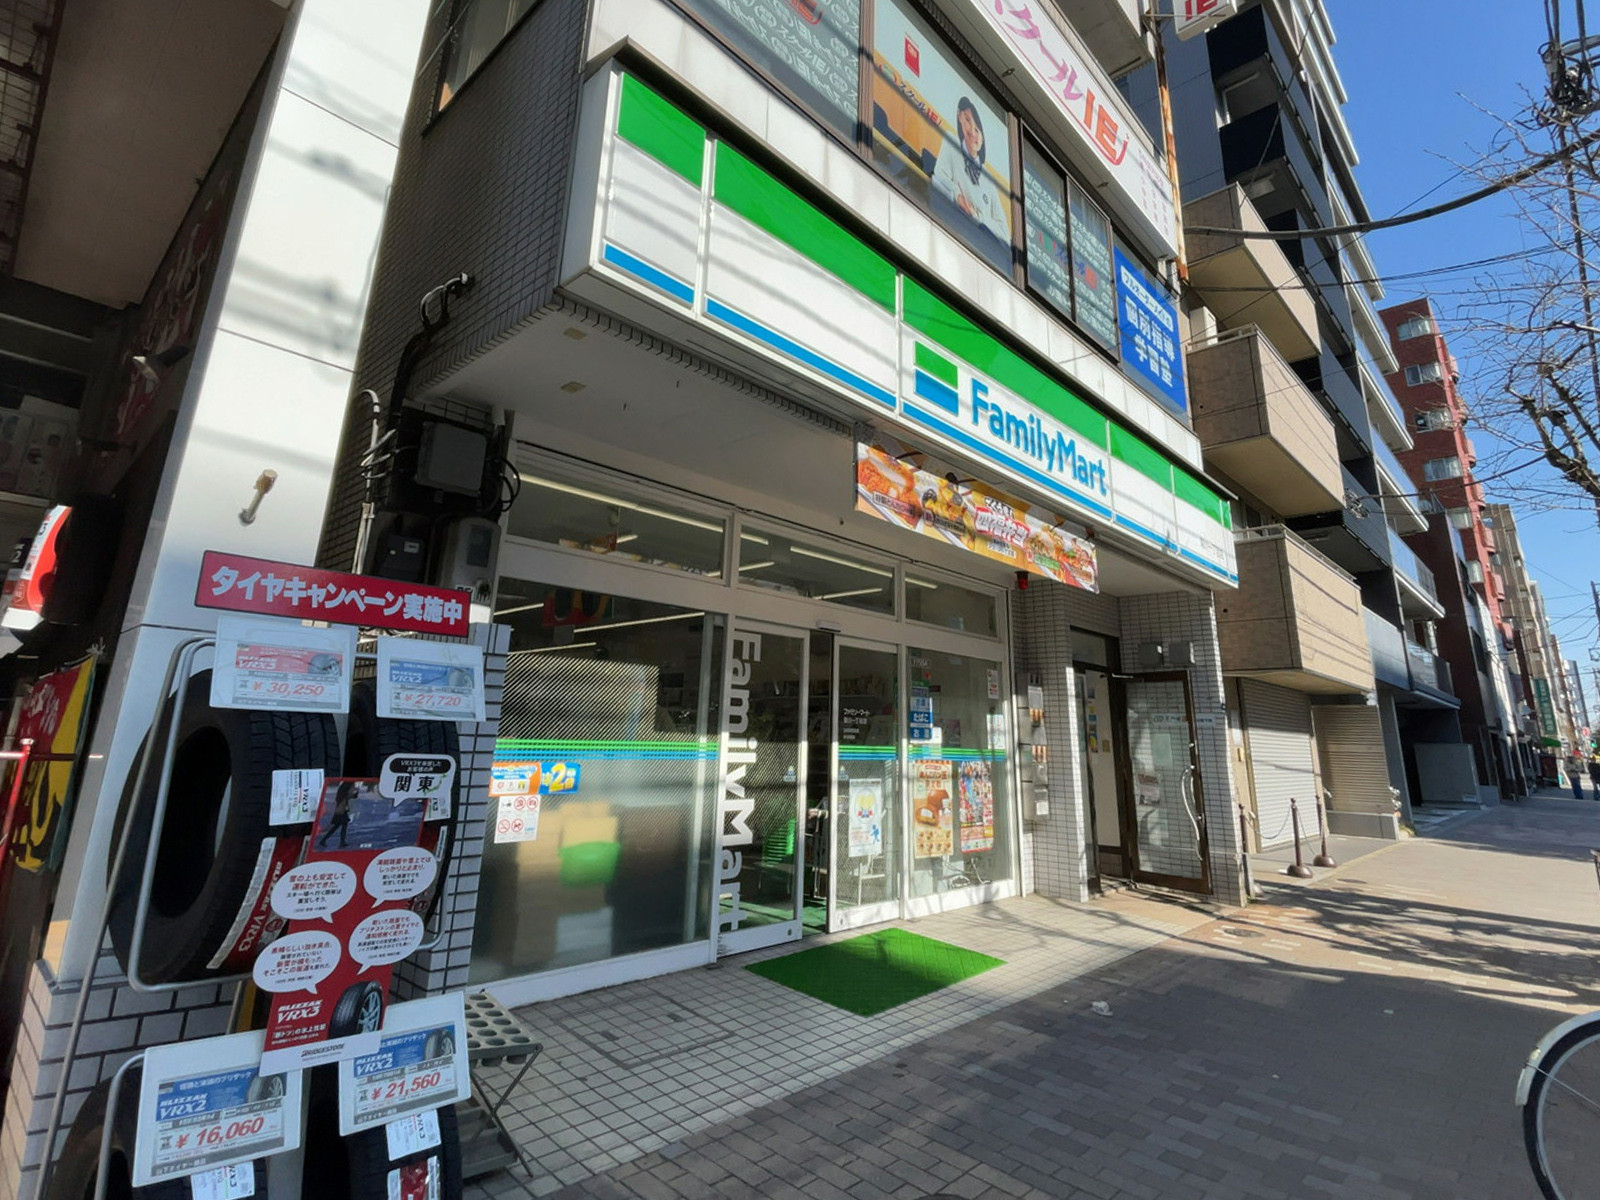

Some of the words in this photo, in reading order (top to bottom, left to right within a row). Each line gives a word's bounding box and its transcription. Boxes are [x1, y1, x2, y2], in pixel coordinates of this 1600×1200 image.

[995, 0, 1118, 160] クールIE
[971, 378, 1107, 497] FamilyMart
[211, 566, 463, 625] タイヤキャンペーン実施中
[266, 681, 325, 697] 30,250
[415, 693, 463, 707] 27,720
[718, 633, 761, 934] FamilyMart
[238, 915, 266, 952] VRX3
[278, 1005, 320, 1024] VRX3
[355, 1058, 393, 1076] VRX2
[385, 1071, 441, 1100] 21,560
[159, 1101, 207, 1120] VRX2
[175, 1132, 190, 1149] ¥
[197, 1116, 265, 1147] 16,060
